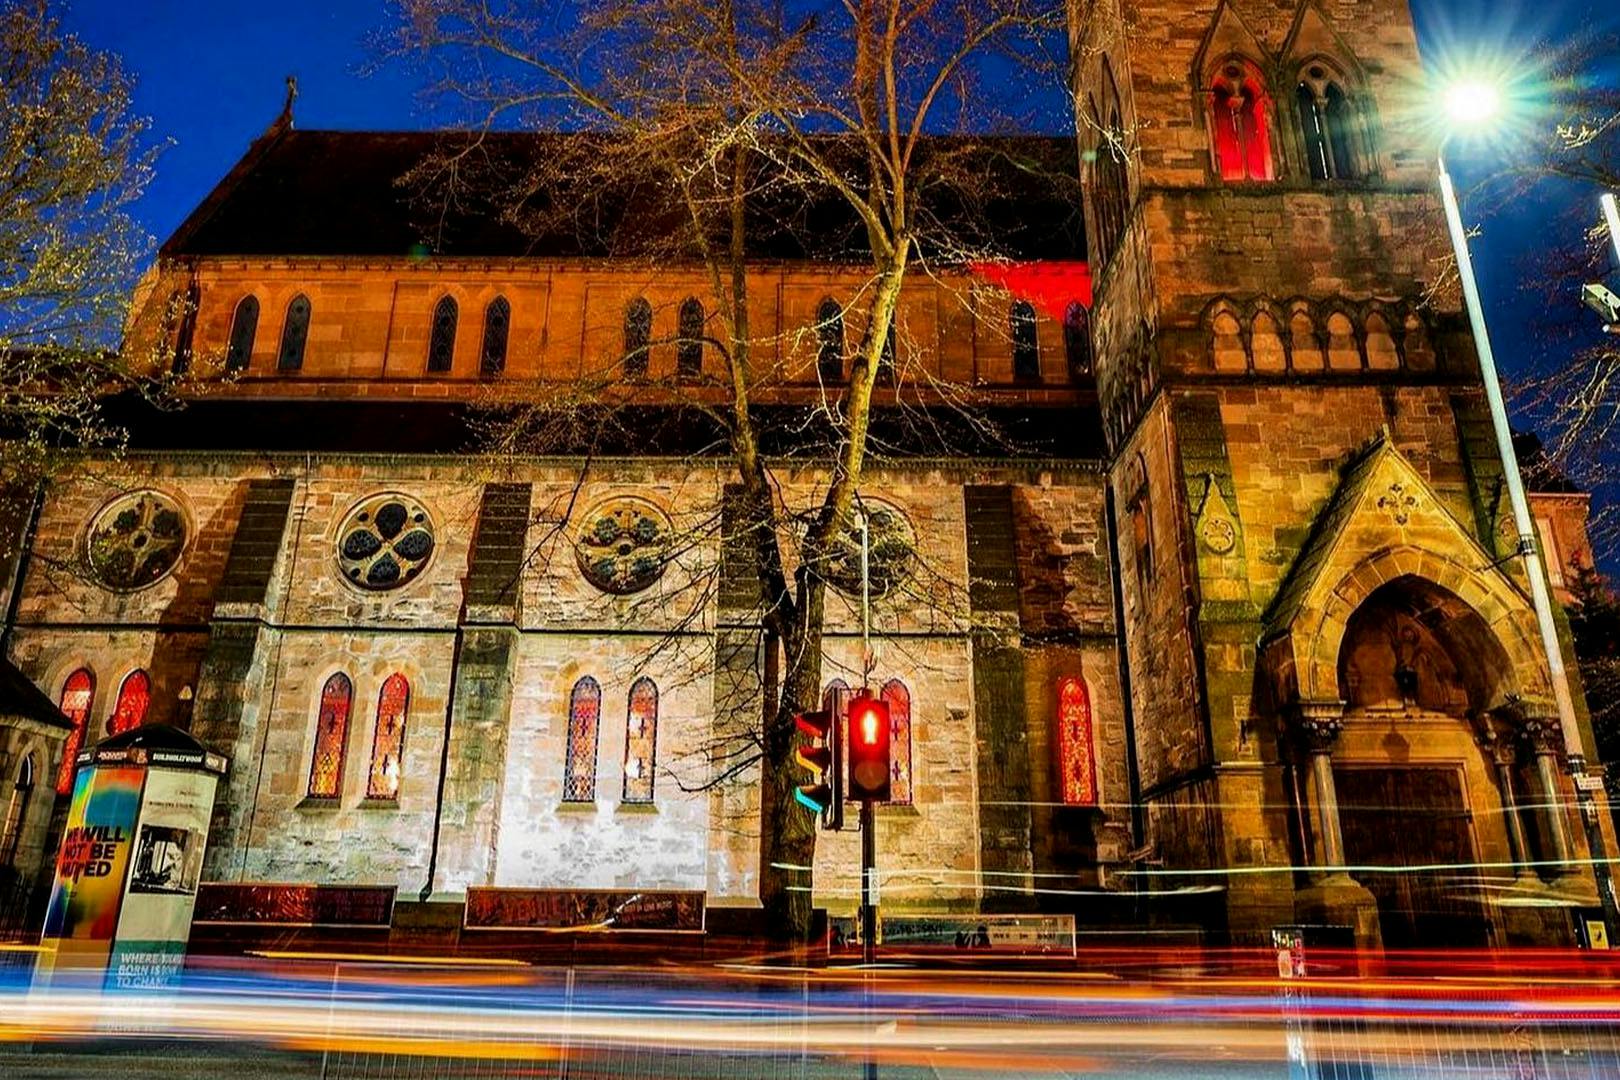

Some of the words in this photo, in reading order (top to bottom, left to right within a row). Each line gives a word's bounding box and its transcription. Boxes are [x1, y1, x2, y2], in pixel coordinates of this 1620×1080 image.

[83, 825, 125, 842] WILL
[64, 843, 88, 859] NOT
[89, 844, 117, 859] BE
[121, 952, 160, 964] WHERE
[118, 964, 148, 976] BORN
